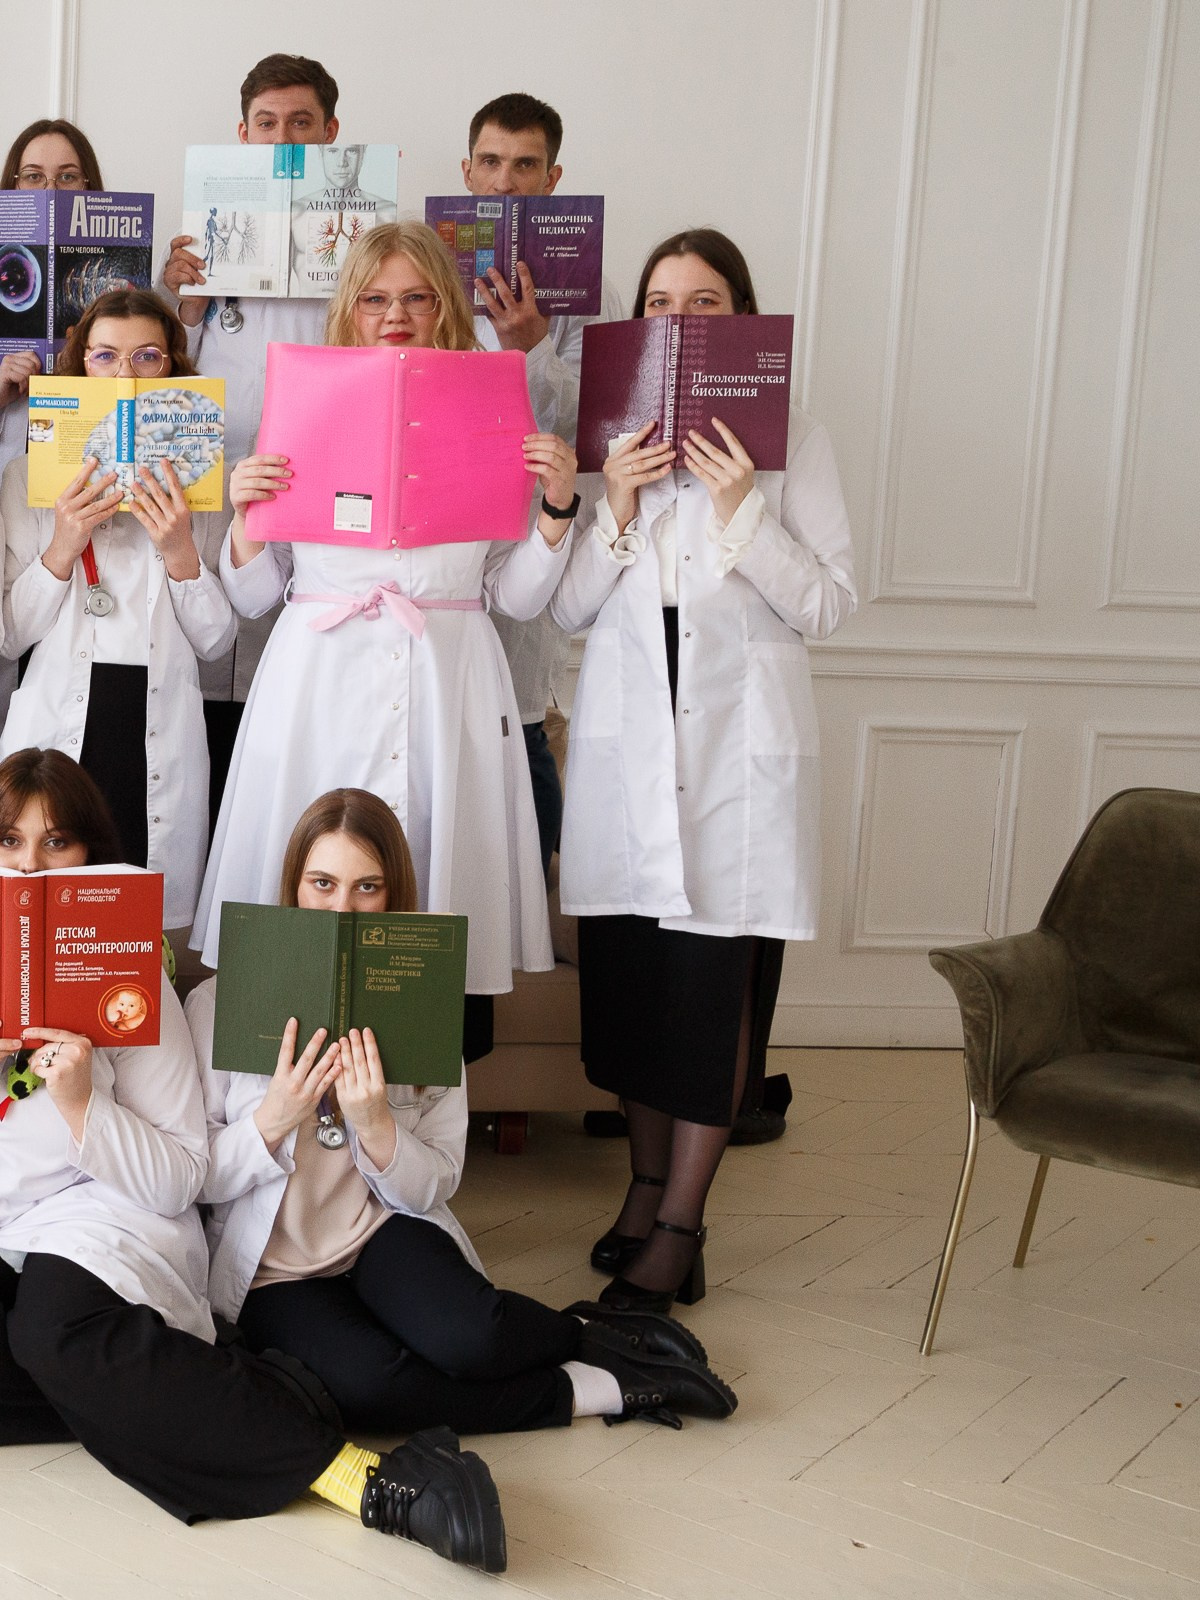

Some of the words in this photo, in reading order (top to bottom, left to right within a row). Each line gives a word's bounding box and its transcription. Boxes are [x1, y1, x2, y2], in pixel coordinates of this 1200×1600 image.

[323, 188, 362, 198] АТЛАС
[306, 202, 376, 211] АНАТОМИИ
[70, 196, 142, 238] Атлас
[531, 215, 594, 224] СПРАВОЧНИК
[538, 226, 586, 235] ПЕДИАТРА
[308, 272, 339, 282] ЧЕЛО
[668, 325, 679, 369] биохимия
[692, 372, 785, 384] Патологическая
[692, 384, 758, 397] биохимия
[664, 370, 676, 440] Патологическая
[142, 413, 218, 423] ФАРМАКОЛОГИЯ
[200, 426, 215, 435] light
[20, 916, 30, 948] ДЕТСКАЯ
[55, 927, 96, 940] ДЕТСКАЯ
[56, 942, 153, 954] ГАСТРОЭНТЕРОЛОГИЯ
[366, 967, 421, 976] Пропедевтика
[20, 950, 30, 1026] ГАСТРОЭНТЕРОЛОГИЯ
[366, 983, 400, 992] болезней
